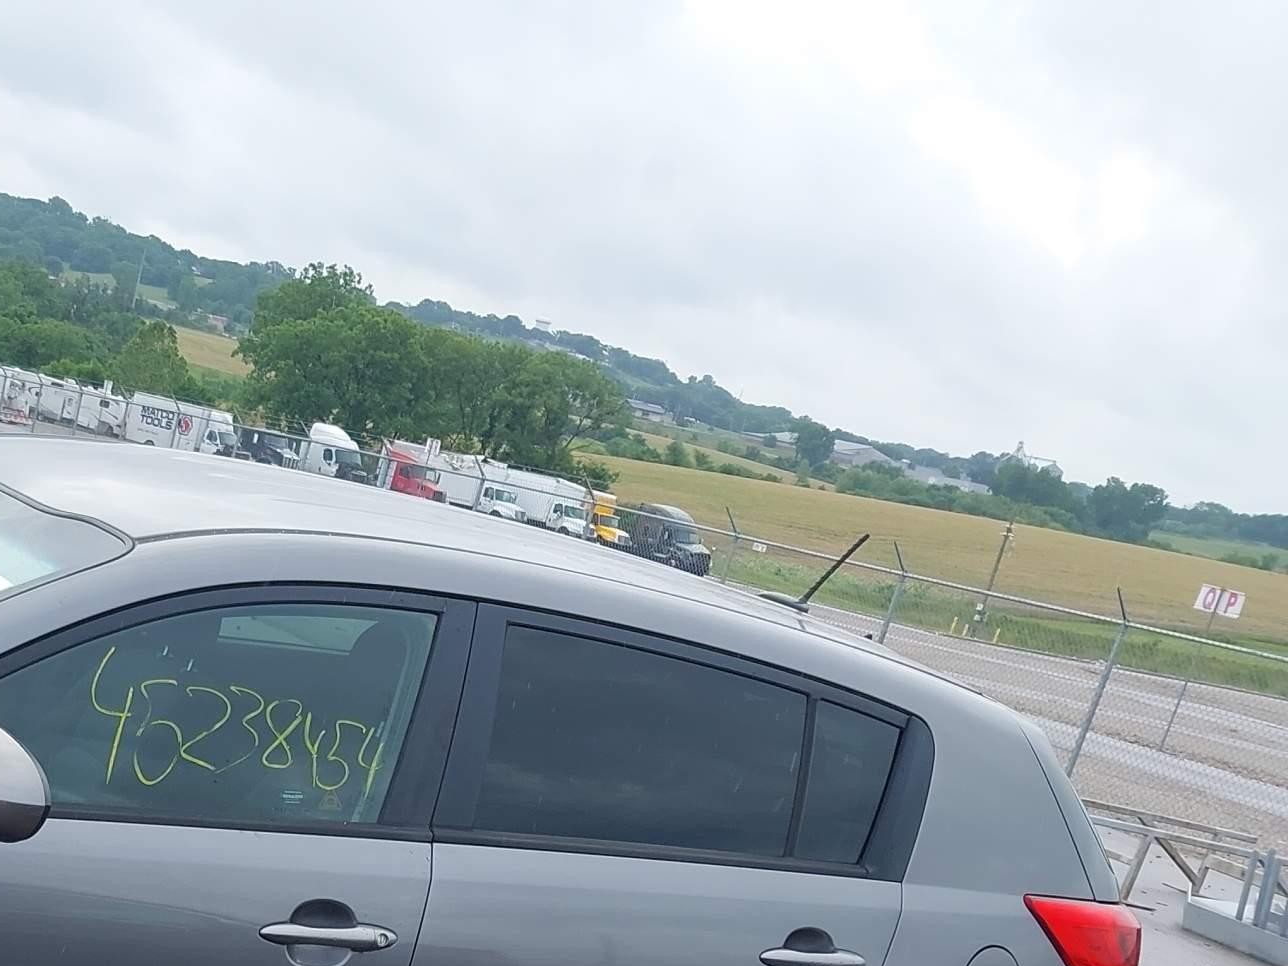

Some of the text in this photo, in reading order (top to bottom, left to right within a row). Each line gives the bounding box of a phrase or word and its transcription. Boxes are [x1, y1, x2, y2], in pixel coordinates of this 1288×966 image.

[140, 414, 173, 430] TOOLS
[141, 405, 175, 420] MATCO
[1223, 591, 1238, 614] P
[89, 646, 385, 799] 45238454
